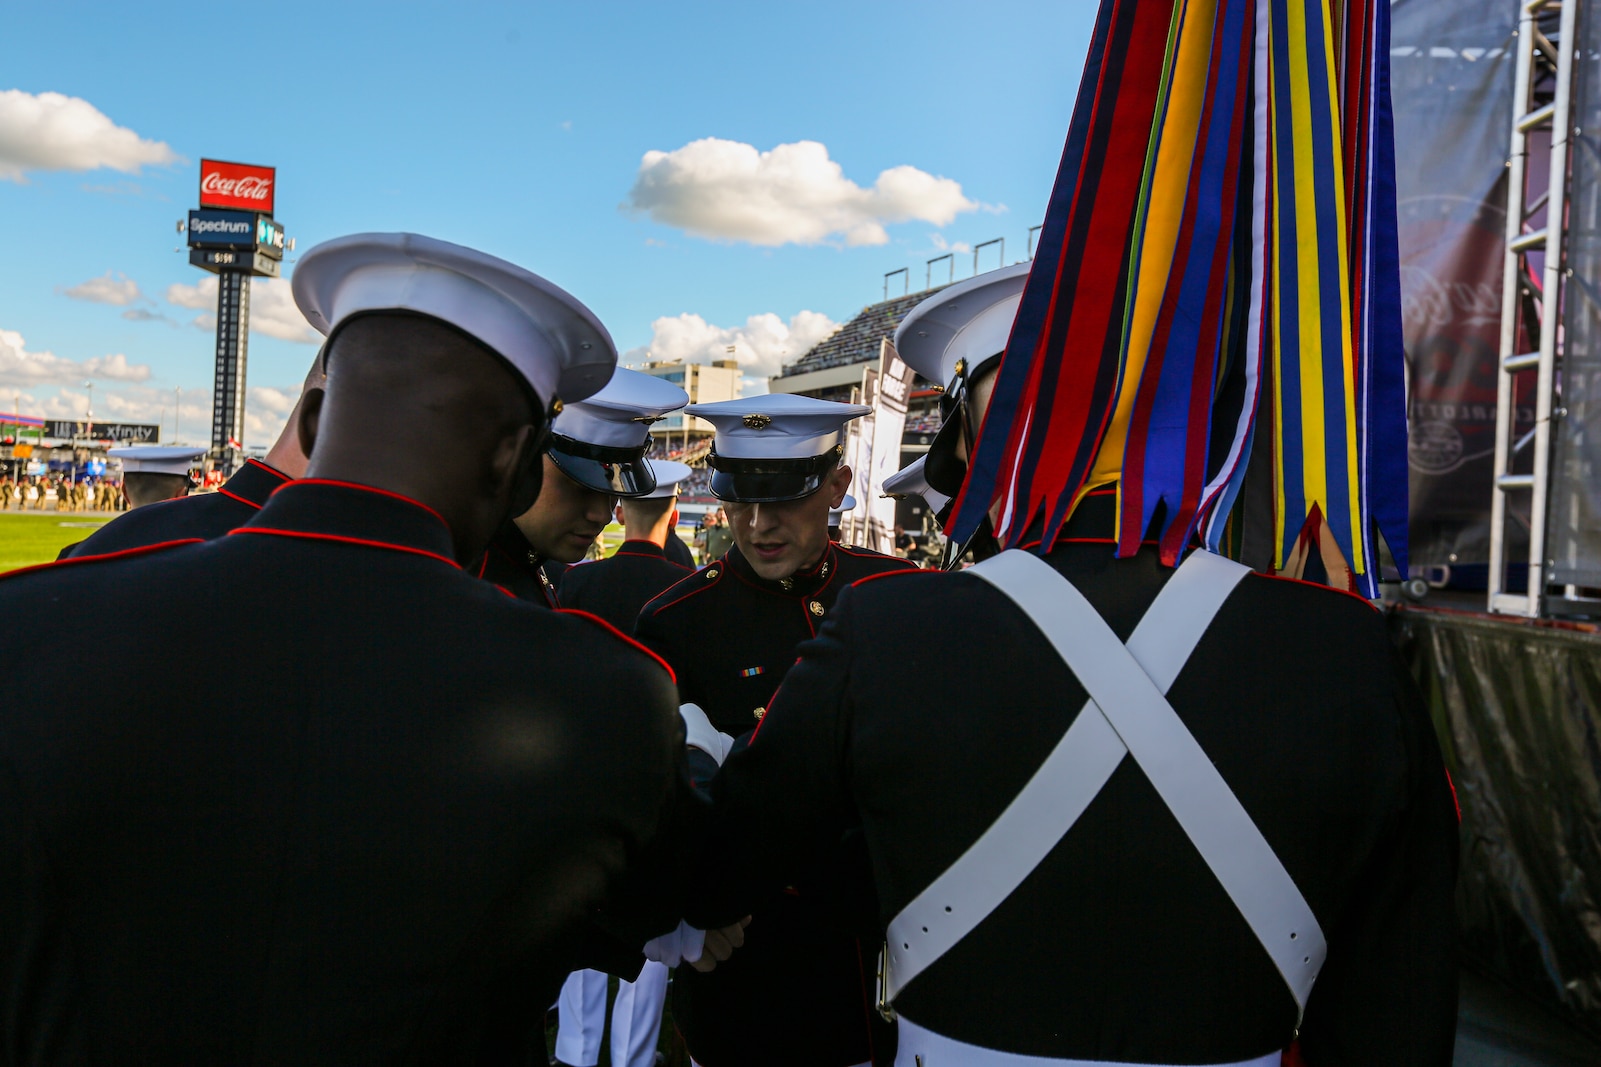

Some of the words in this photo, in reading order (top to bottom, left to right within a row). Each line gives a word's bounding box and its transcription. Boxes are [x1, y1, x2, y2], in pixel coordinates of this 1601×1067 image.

[201, 172, 273, 200] Coca-Cola
[191, 218, 249, 234] Spectrum
[106, 425, 152, 439] xfinity
